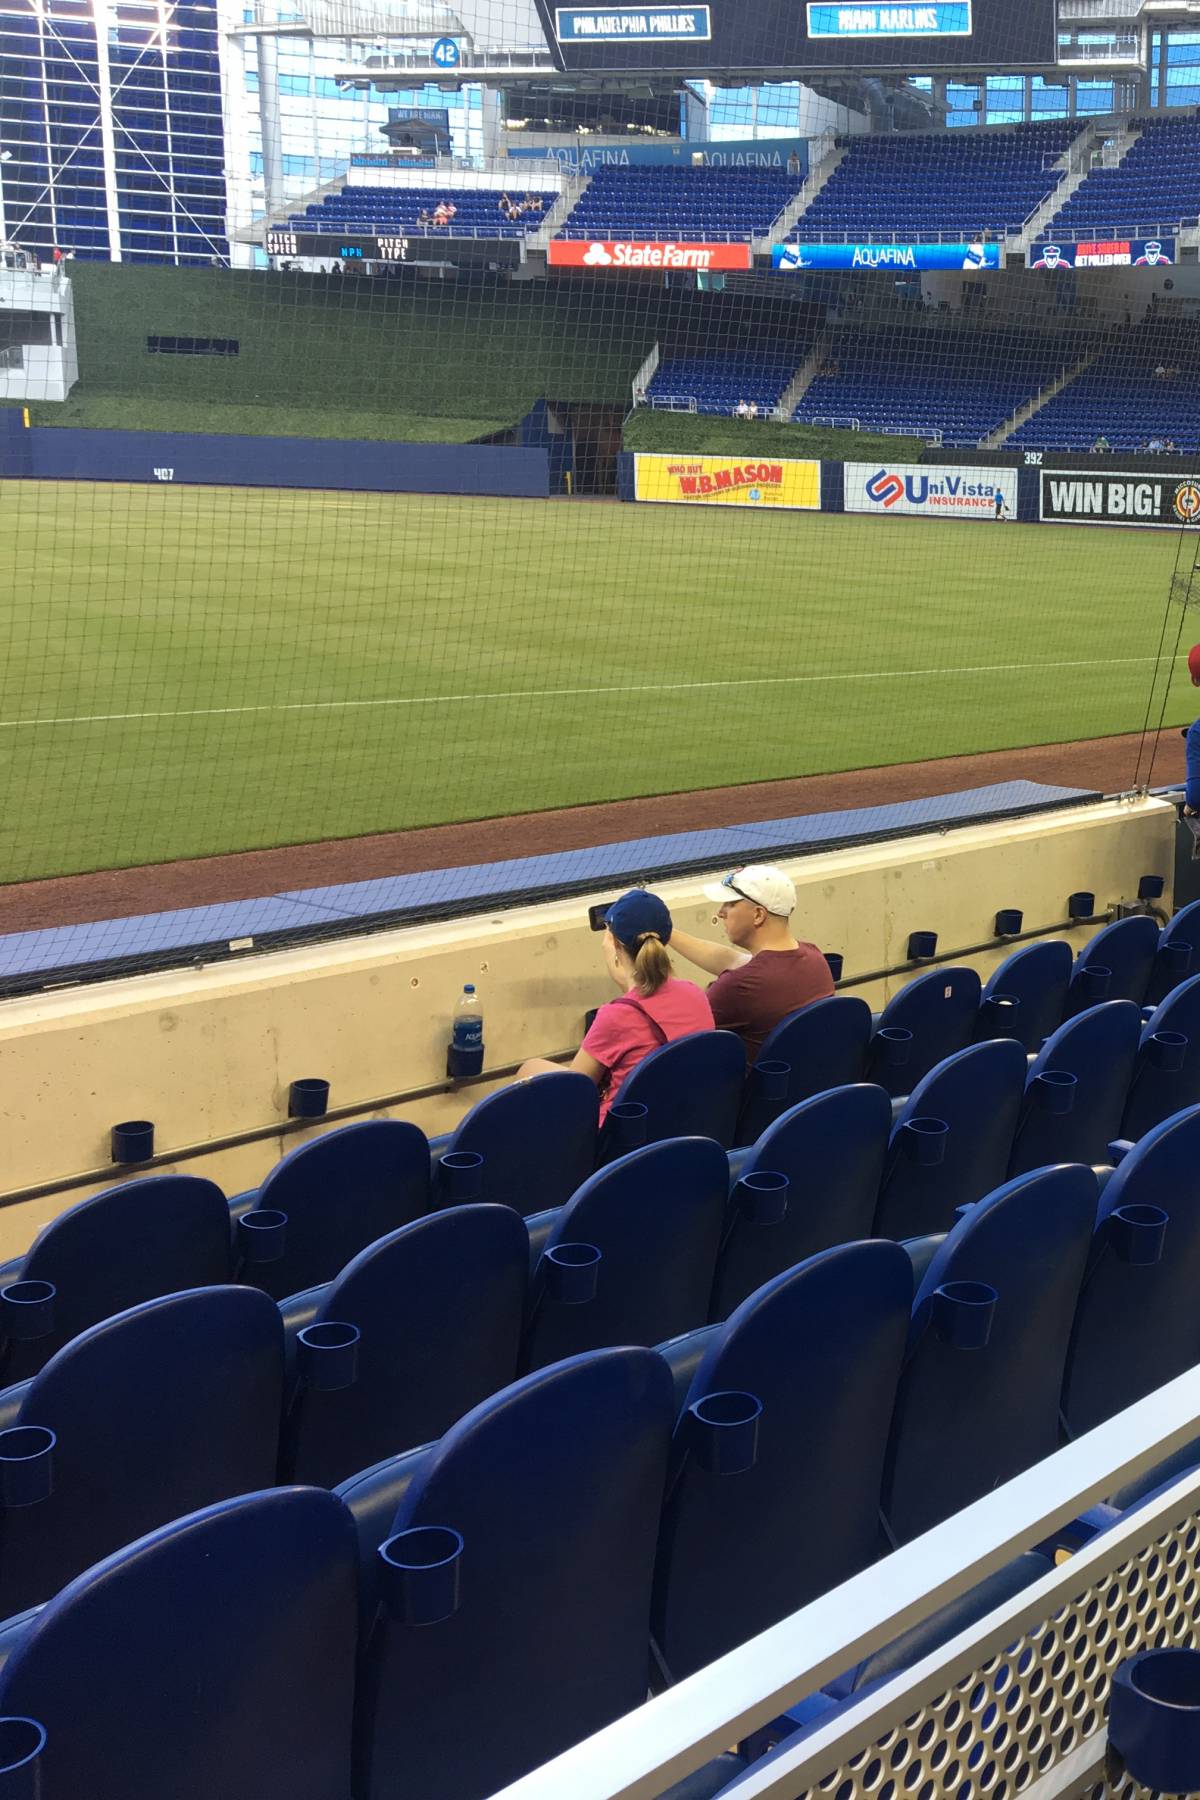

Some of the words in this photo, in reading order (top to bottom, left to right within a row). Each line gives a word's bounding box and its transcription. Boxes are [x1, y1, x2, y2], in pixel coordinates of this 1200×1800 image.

[573, 15, 648, 34] PHILADELPHIA
[650, 15, 696, 33] PHILLIES
[880, 8, 938, 30] MARLINS
[435, 45, 455, 62] 42
[267, 233, 297, 244] PITCH
[377, 238, 409, 249] PITCH
[267, 244, 297, 254] SPEED
[341, 248, 363, 257] MPH
[380, 248, 406, 259] TYPE
[852, 246, 917, 267] AQUAFINA
[1024, 452, 1043, 465] 392
[153, 467, 174, 481] 407
[904, 475, 995, 504] UniVista
[928, 497, 995, 508] INSURANCE
[1050, 481, 1103, 514] WIN
[1107, 482, 1162, 516] BIG!
